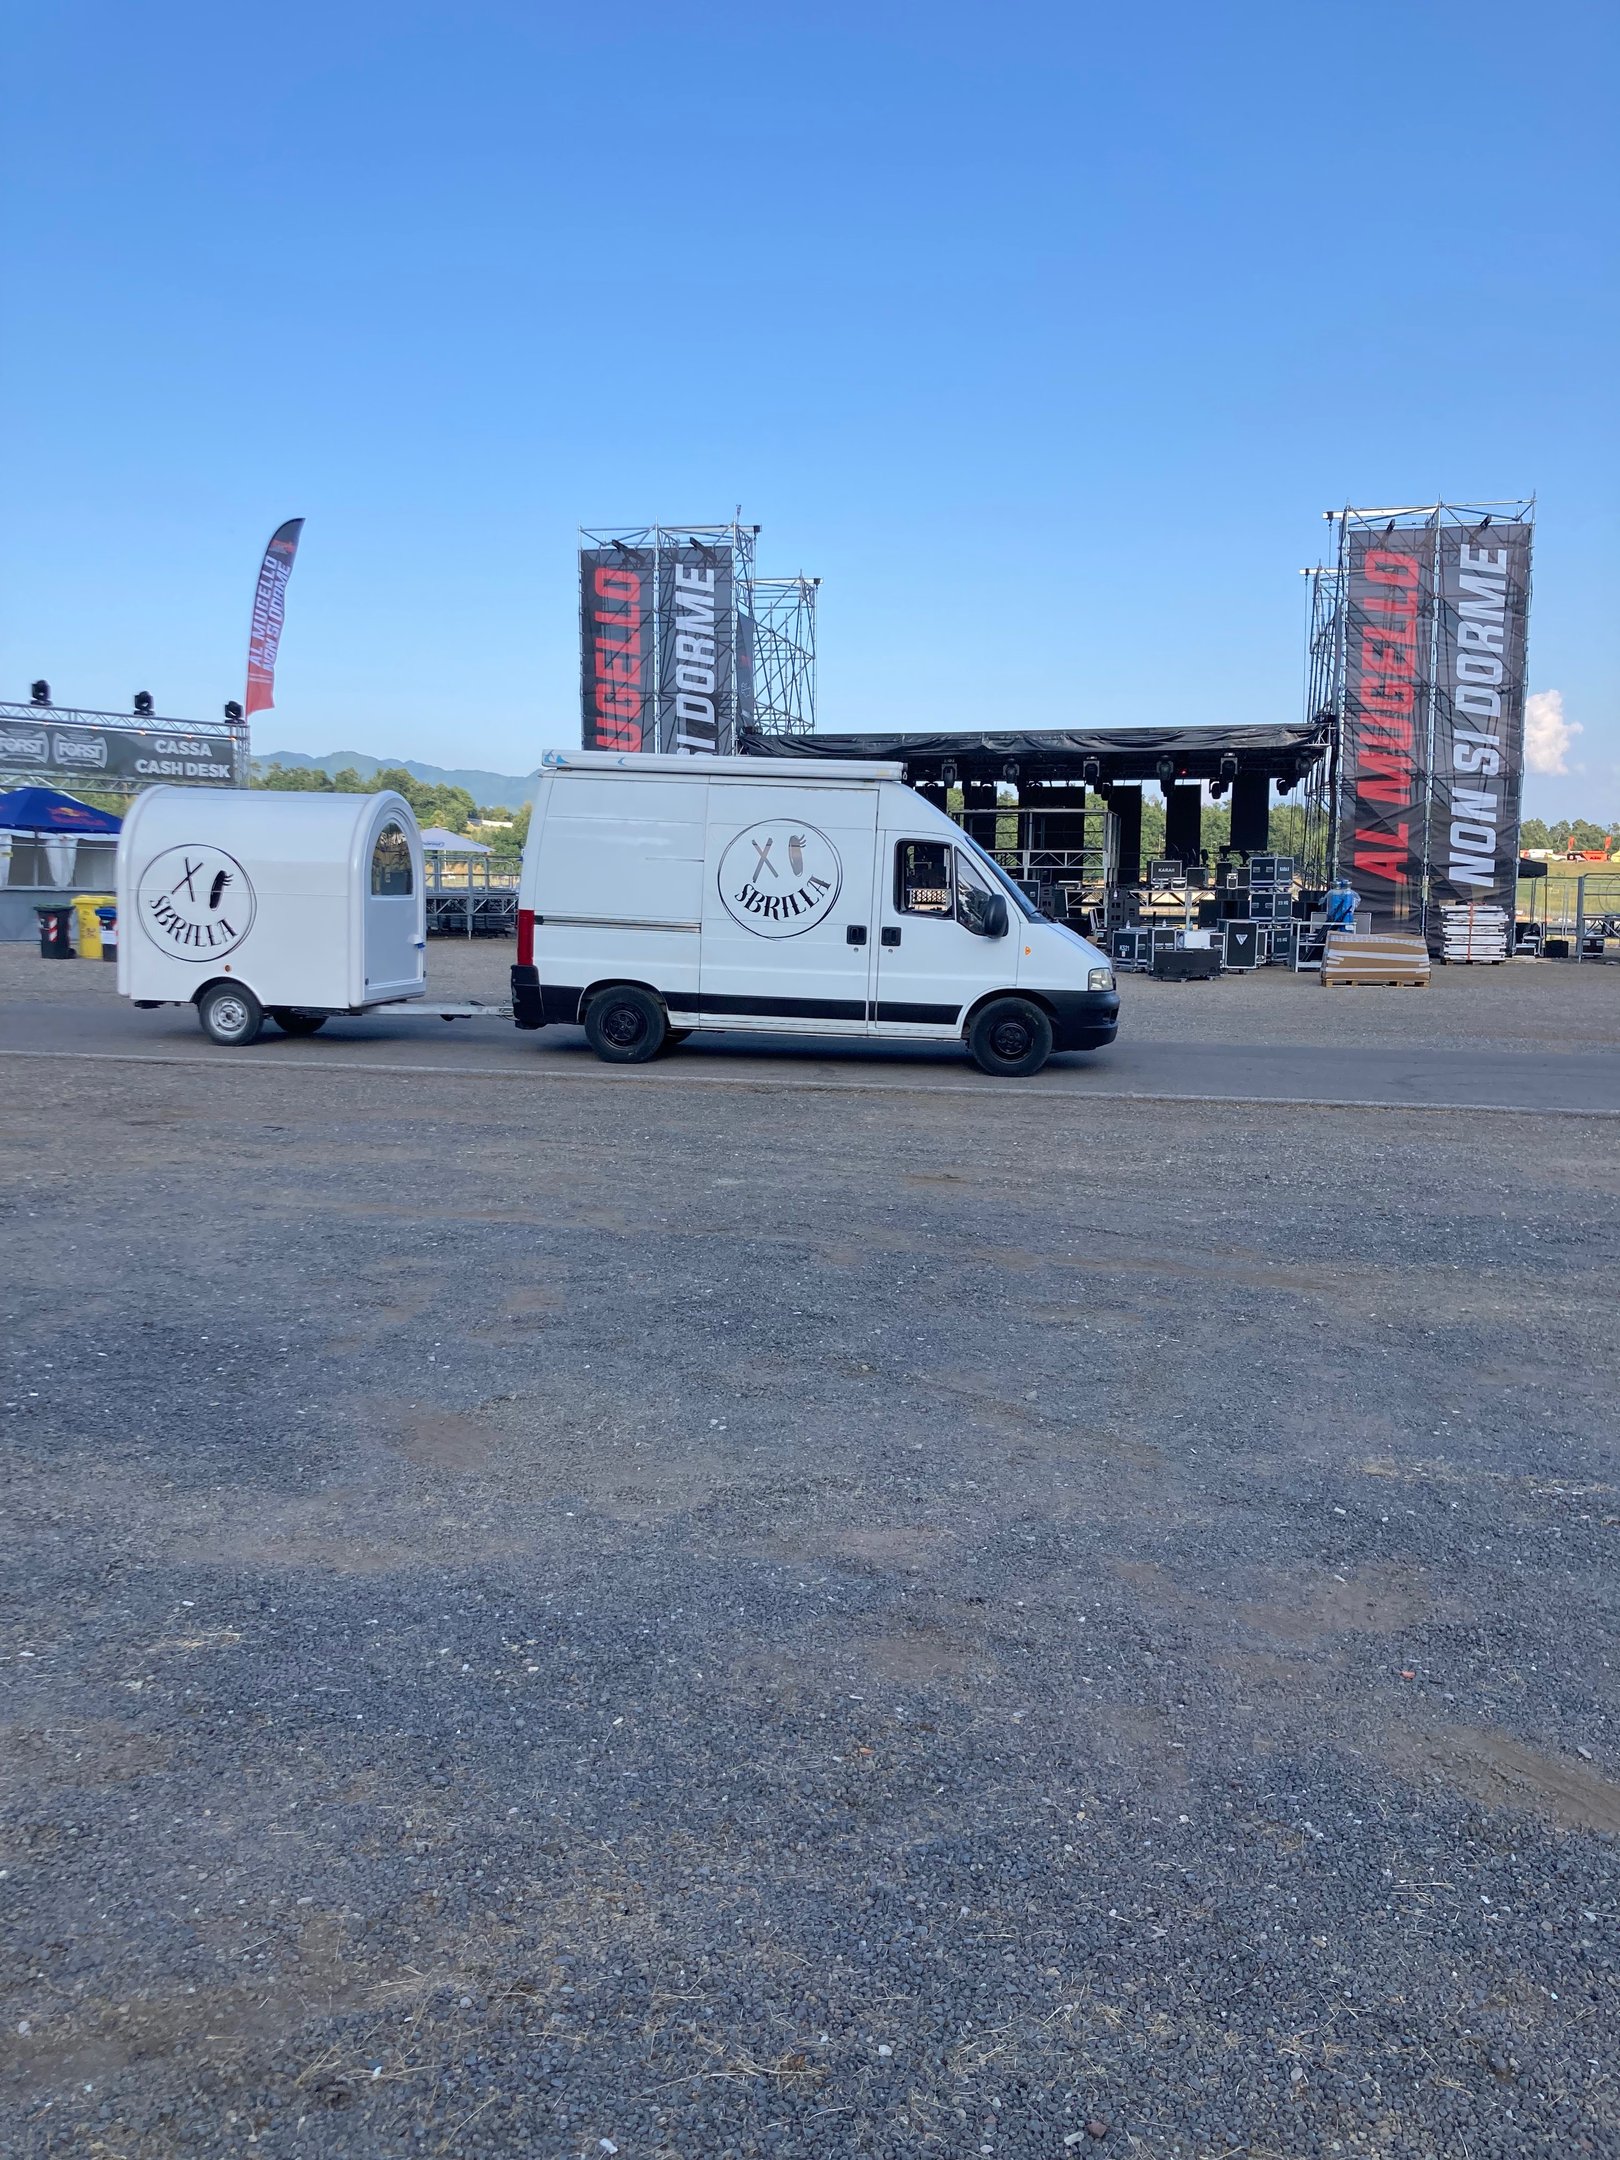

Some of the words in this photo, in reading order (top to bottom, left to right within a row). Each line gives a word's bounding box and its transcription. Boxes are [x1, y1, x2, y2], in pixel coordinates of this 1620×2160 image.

[251, 555, 278, 641] MUGELLO
[267, 560, 291, 622] DORME
[250, 643, 263, 668] AL
[262, 638, 278, 672] NON
[675, 563, 715, 724] DORME
[1455, 543, 1507, 718] DORME
[595, 567, 642, 752] UGELLO
[1357, 549, 1420, 806] MUGELLO
[0, 737, 43, 754] FORST
[59, 741, 103, 760] FORST
[135, 759, 184, 777] CASH
[185, 764, 232, 779] DESK
[154, 739, 213, 757] CASSA
[1453, 728, 1500, 777] SI
[1353, 823, 1409, 885] AL
[1449, 787, 1498, 888] NON
[149, 895, 239, 948] SBRILLA
[734, 875, 832, 921] SBRILLA
